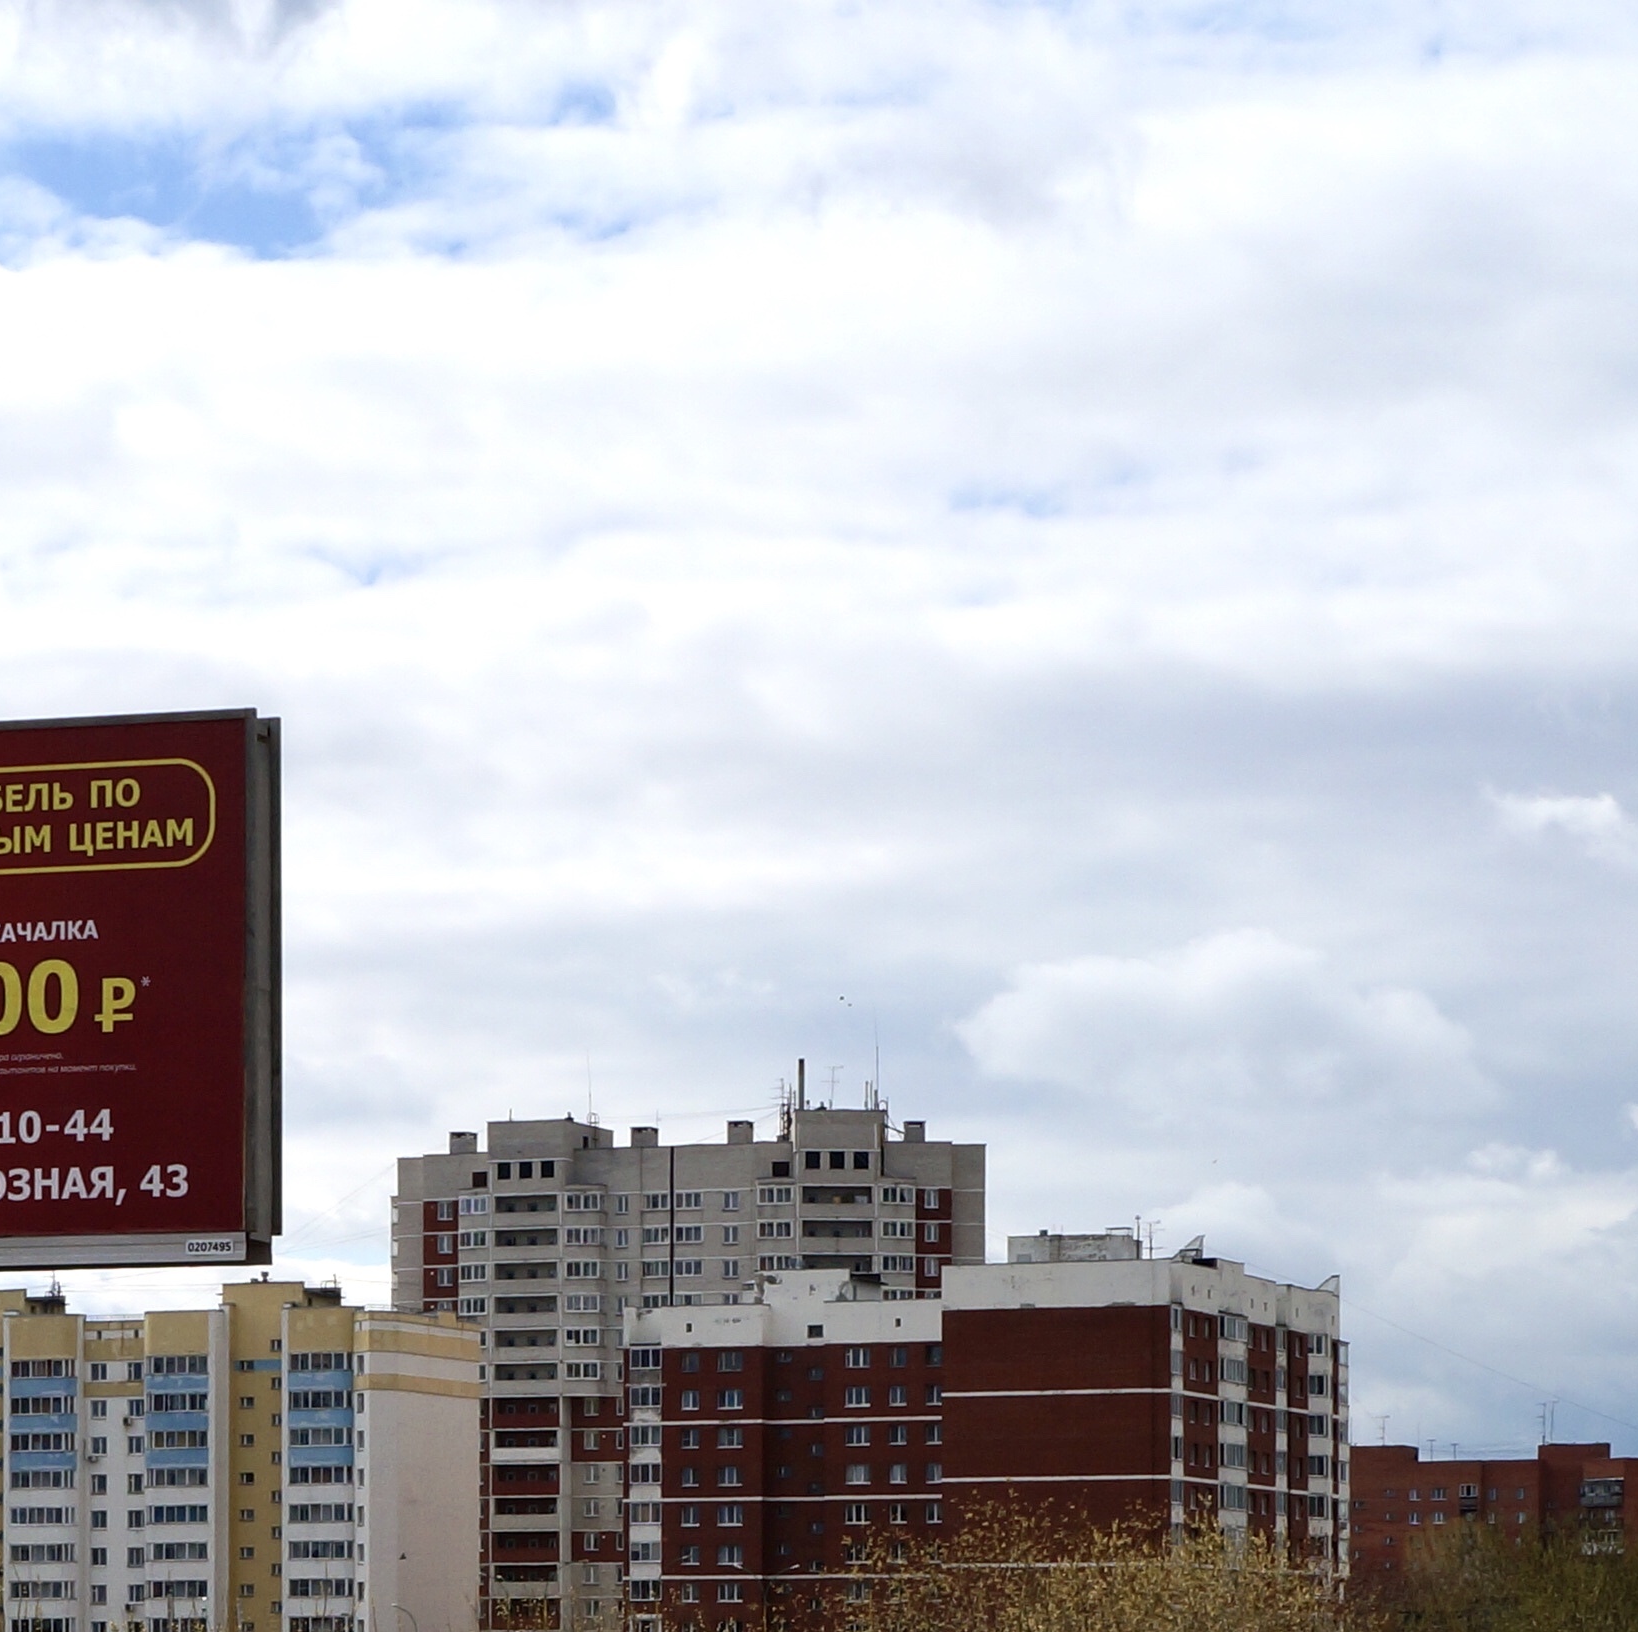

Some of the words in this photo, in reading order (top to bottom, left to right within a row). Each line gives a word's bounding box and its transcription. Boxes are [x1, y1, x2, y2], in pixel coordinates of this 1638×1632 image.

[90, 778, 141, 808] ПО
[69, 818, 195, 857] ЦЕНАМ
[139, 1164, 190, 1199] 43
[187, 1241, 232, 1253] 0207495
